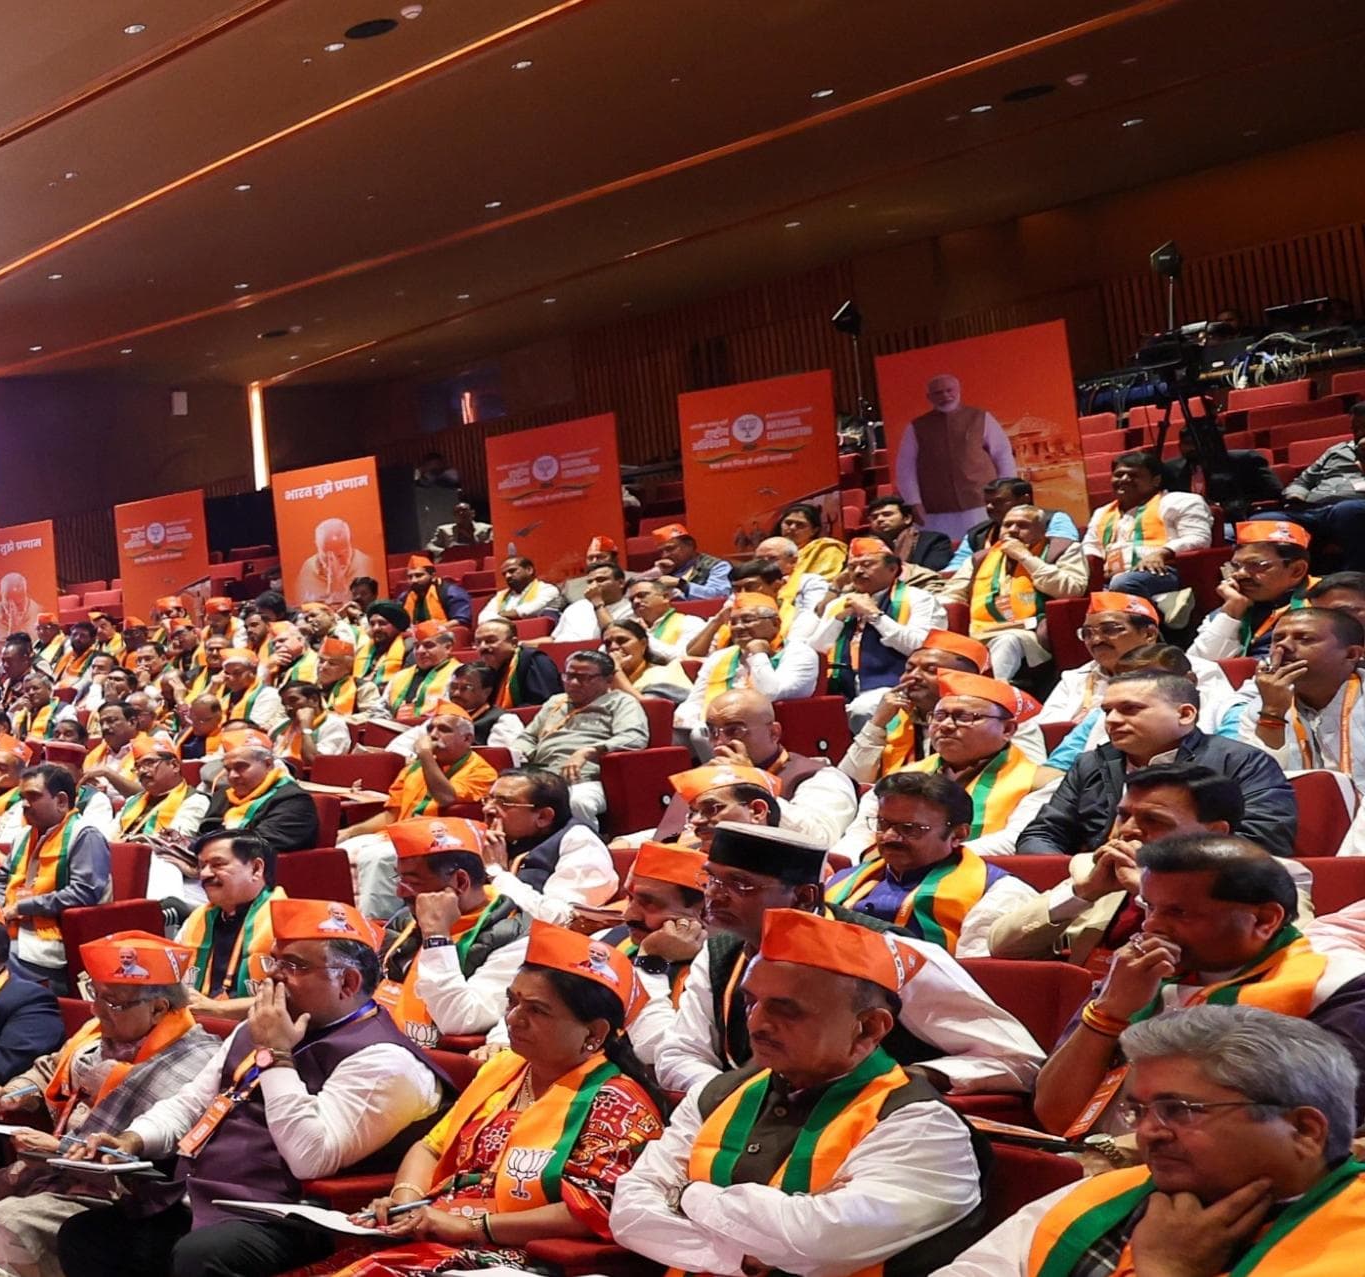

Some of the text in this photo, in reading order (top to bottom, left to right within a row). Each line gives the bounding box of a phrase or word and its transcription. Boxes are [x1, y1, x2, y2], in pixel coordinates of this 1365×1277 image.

[284, 475, 368, 501] भारत तुझे प्रणाम
